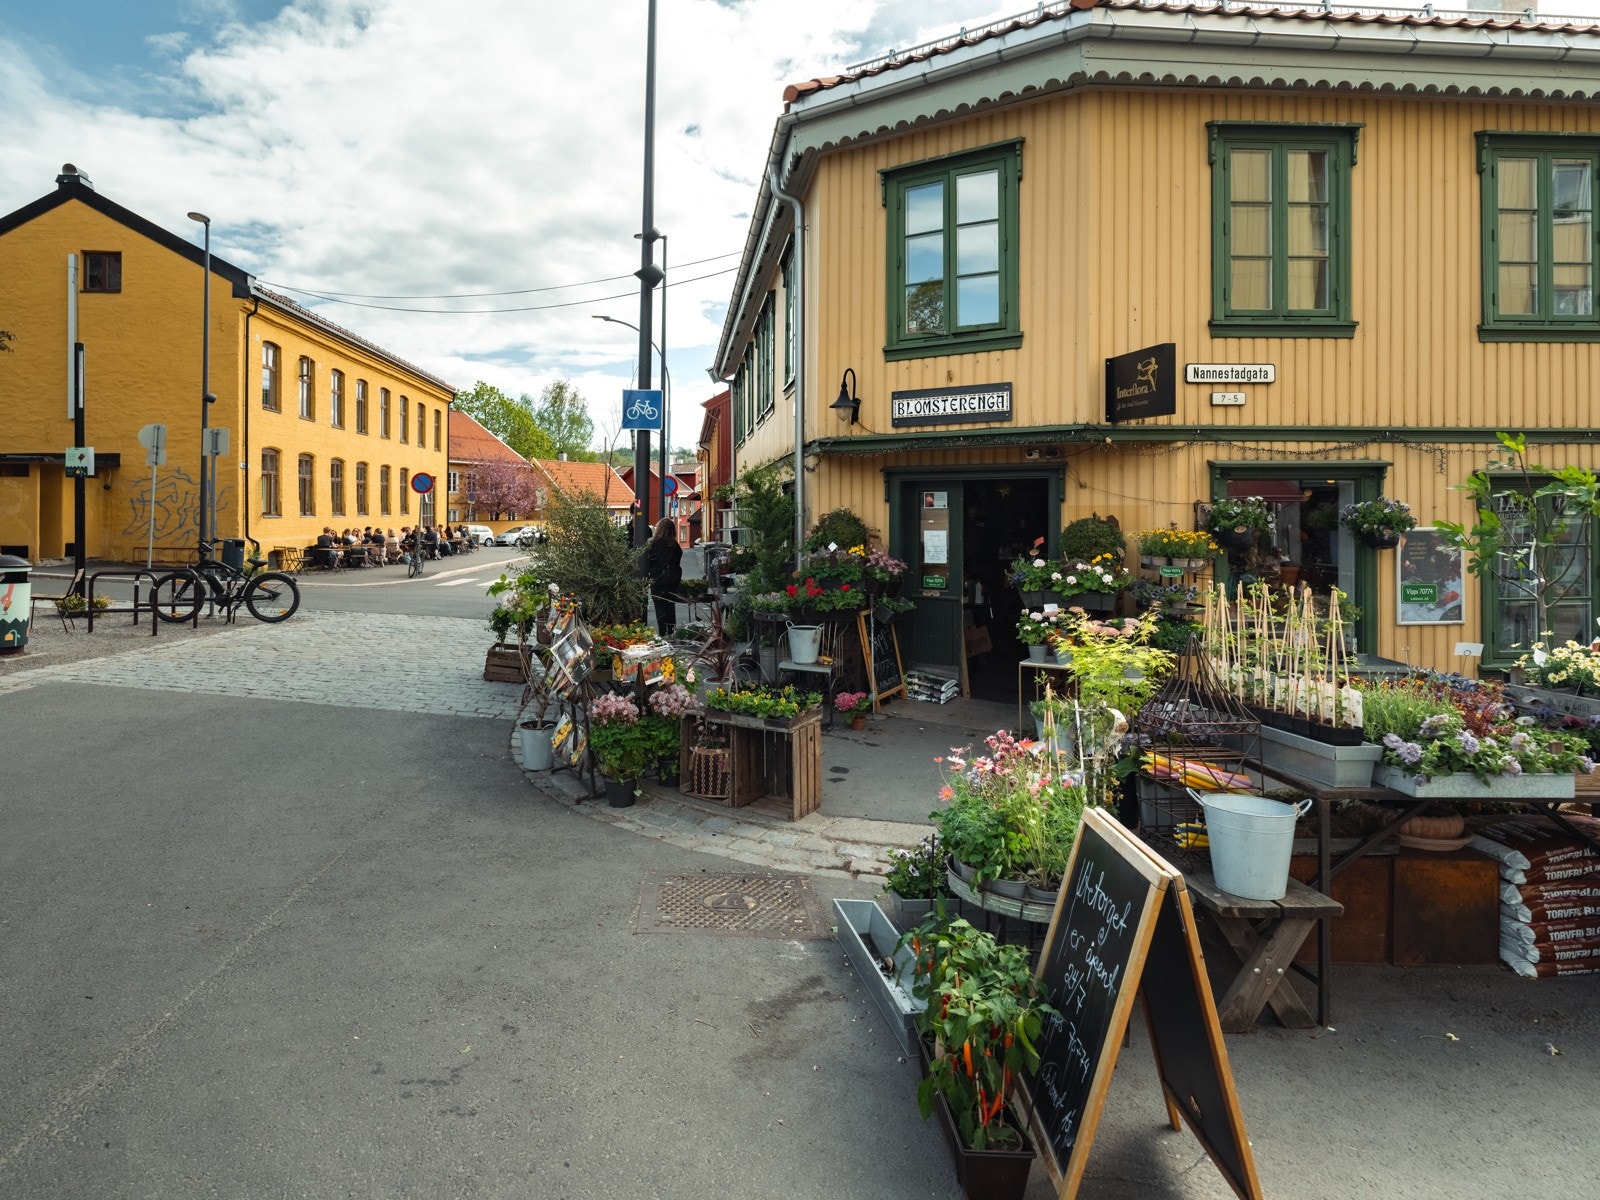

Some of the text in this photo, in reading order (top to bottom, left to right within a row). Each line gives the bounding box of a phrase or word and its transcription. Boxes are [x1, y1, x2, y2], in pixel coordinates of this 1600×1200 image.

[1193, 366, 1269, 382] Nannestadgata
[1116, 383, 1149, 399] Interflora
[897, 394, 1005, 415] BLOMSTERENGA
[1406, 588, 1419, 596] Vipps
[1545, 868, 1583, 881] TORVFRI
[1076, 858, 1131, 945] Utetorget
[1549, 928, 1585, 942] TORVFRI
[1070, 928, 1119, 996] er åpent
[1555, 949, 1591, 961] TORVFRI
[1064, 963, 1087, 1015] 24/7
